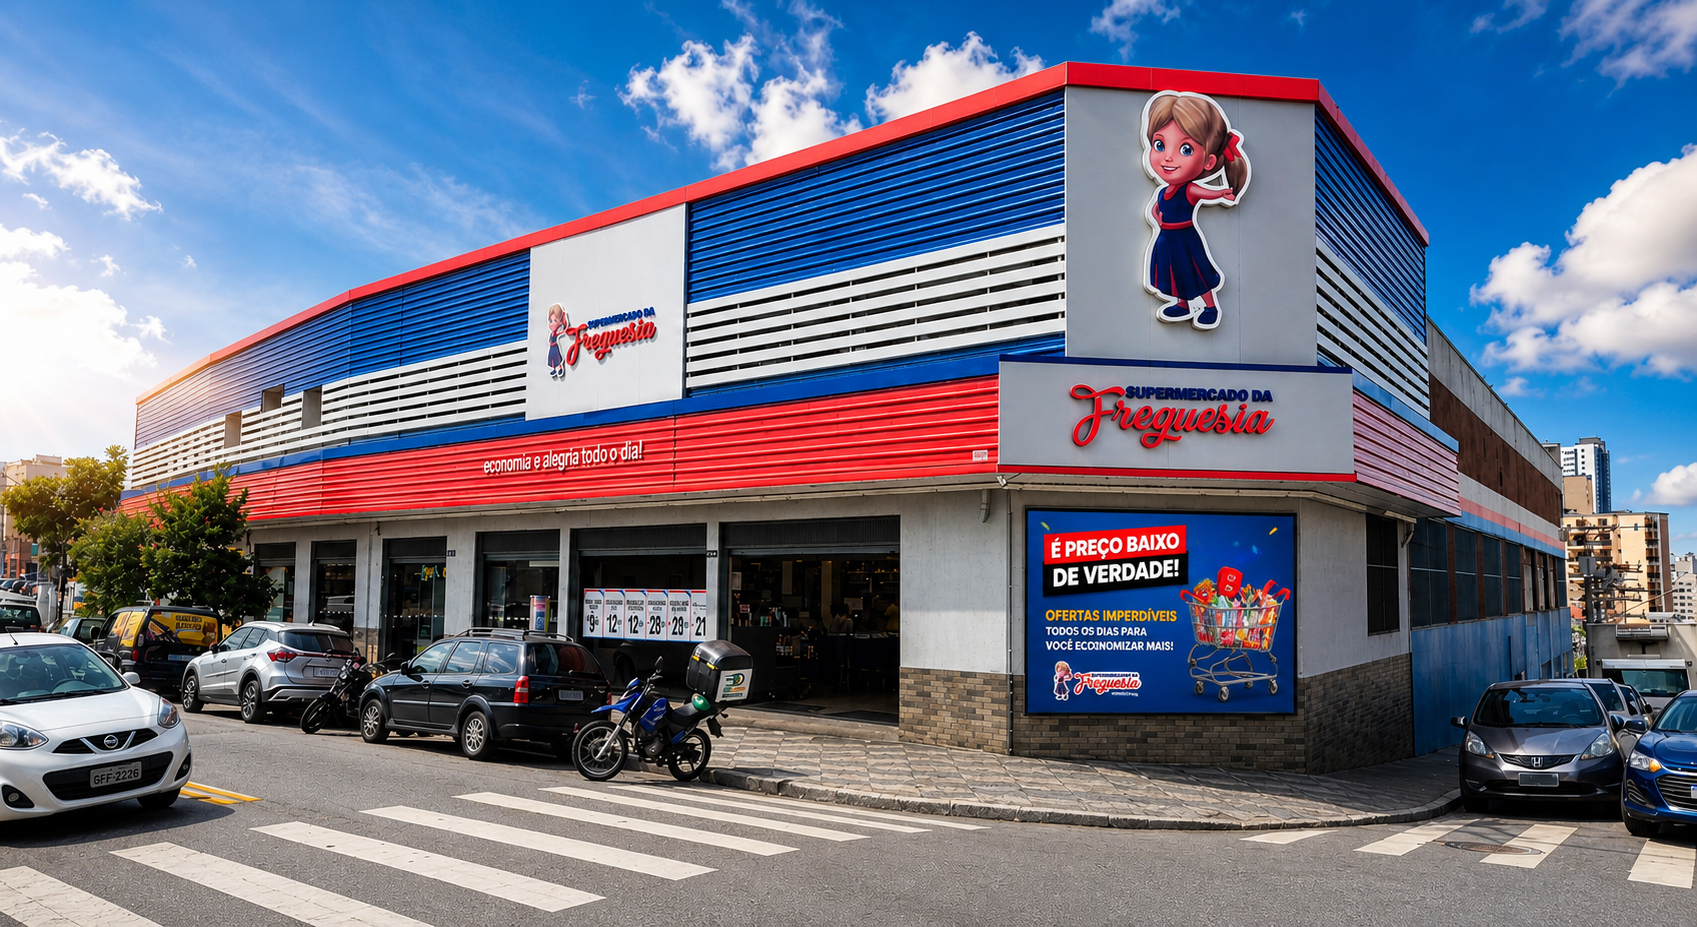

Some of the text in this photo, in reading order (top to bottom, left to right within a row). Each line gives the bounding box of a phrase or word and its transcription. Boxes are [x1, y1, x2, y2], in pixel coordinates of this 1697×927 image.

[587, 306, 656, 330] SUPERMERCADO DA
[565, 318, 657, 366] Freguesia
[1125, 385, 1274, 402] SUPERMERCADO DA
[1070, 384, 1275, 449] Freguesia
[483, 439, 643, 473] economia e alegria todo o dia!
[1051, 532, 1180, 560] É PREÇO BAIXO
[1053, 558, 1180, 588] DE VERDADE!
[1045, 607, 1178, 622] OFERTAS IMPERDÍVEIS
[1045, 626, 1148, 636] TODOS OS DIAS PARA
[1146, 641, 1174, 651] MAIS!
